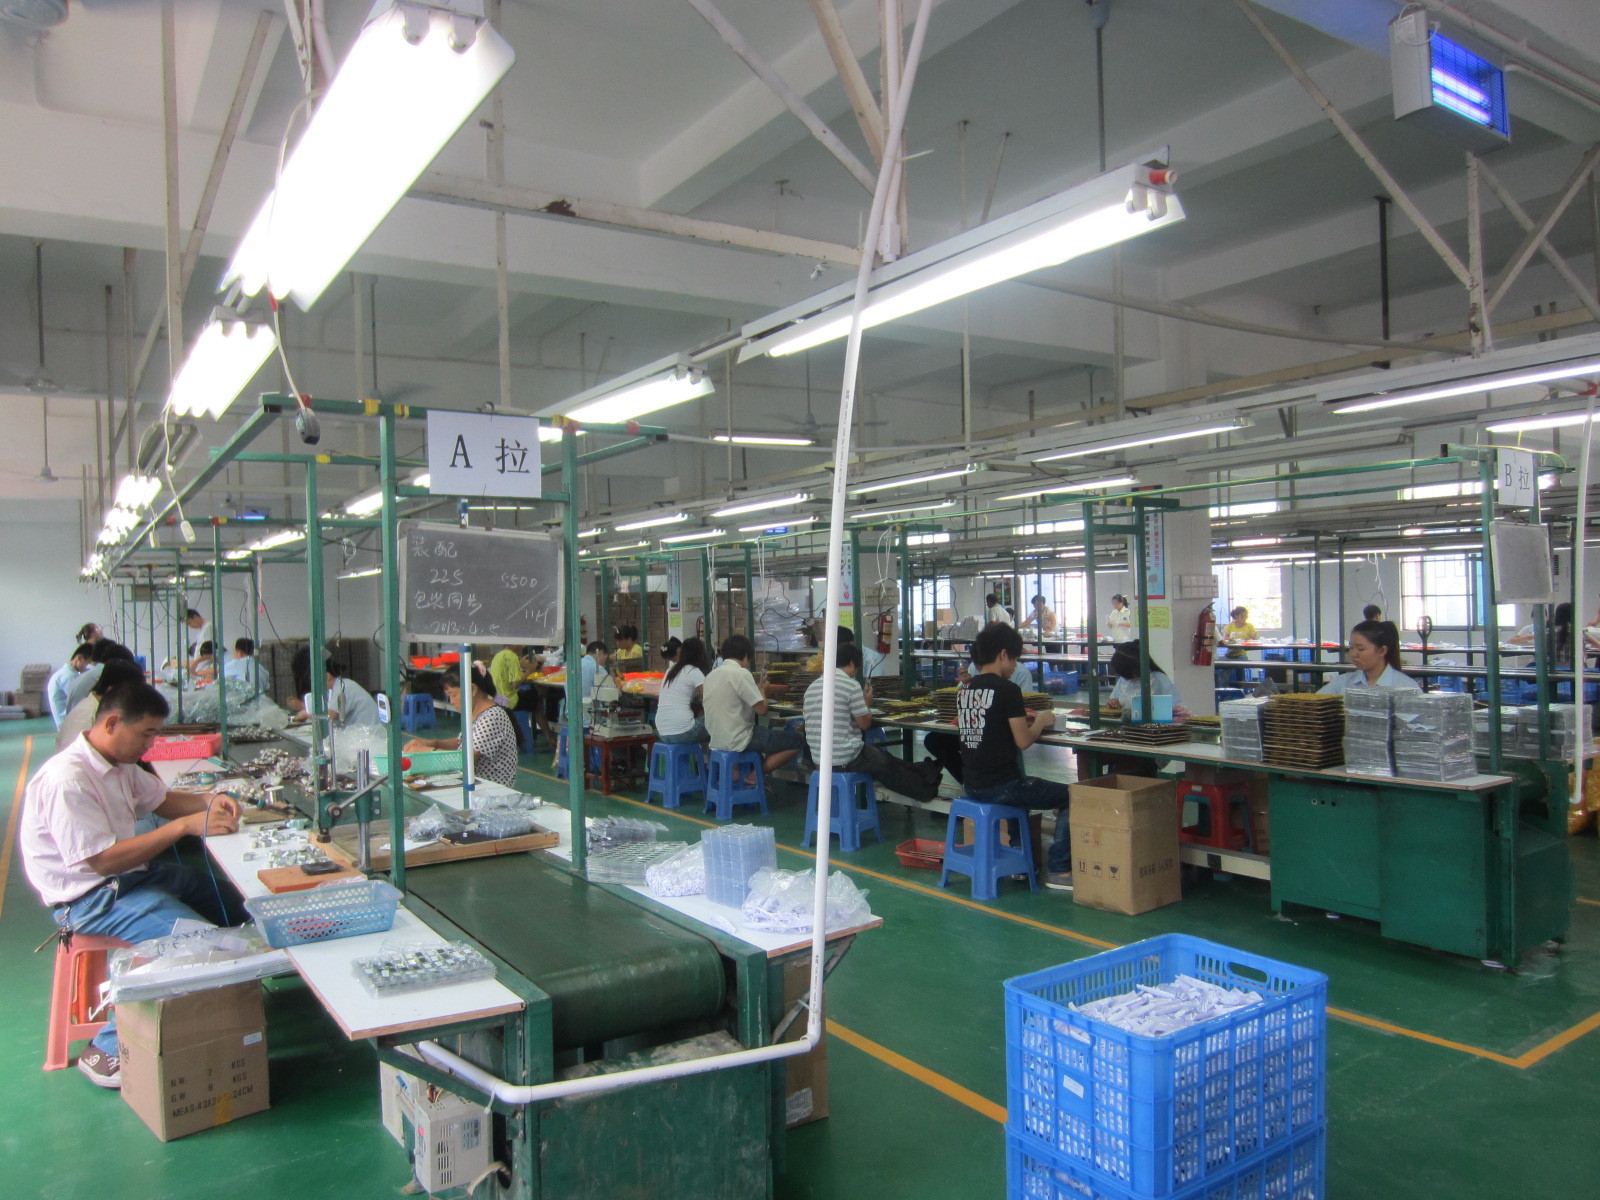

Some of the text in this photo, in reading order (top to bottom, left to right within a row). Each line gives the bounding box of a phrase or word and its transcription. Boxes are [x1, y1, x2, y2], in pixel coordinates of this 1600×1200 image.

[449, 434, 530, 474] A 拉
[1505, 464, 1530, 490] B 拉
[231, 1058, 246, 1069] KGS
[232, 1071, 247, 1083] KGS
